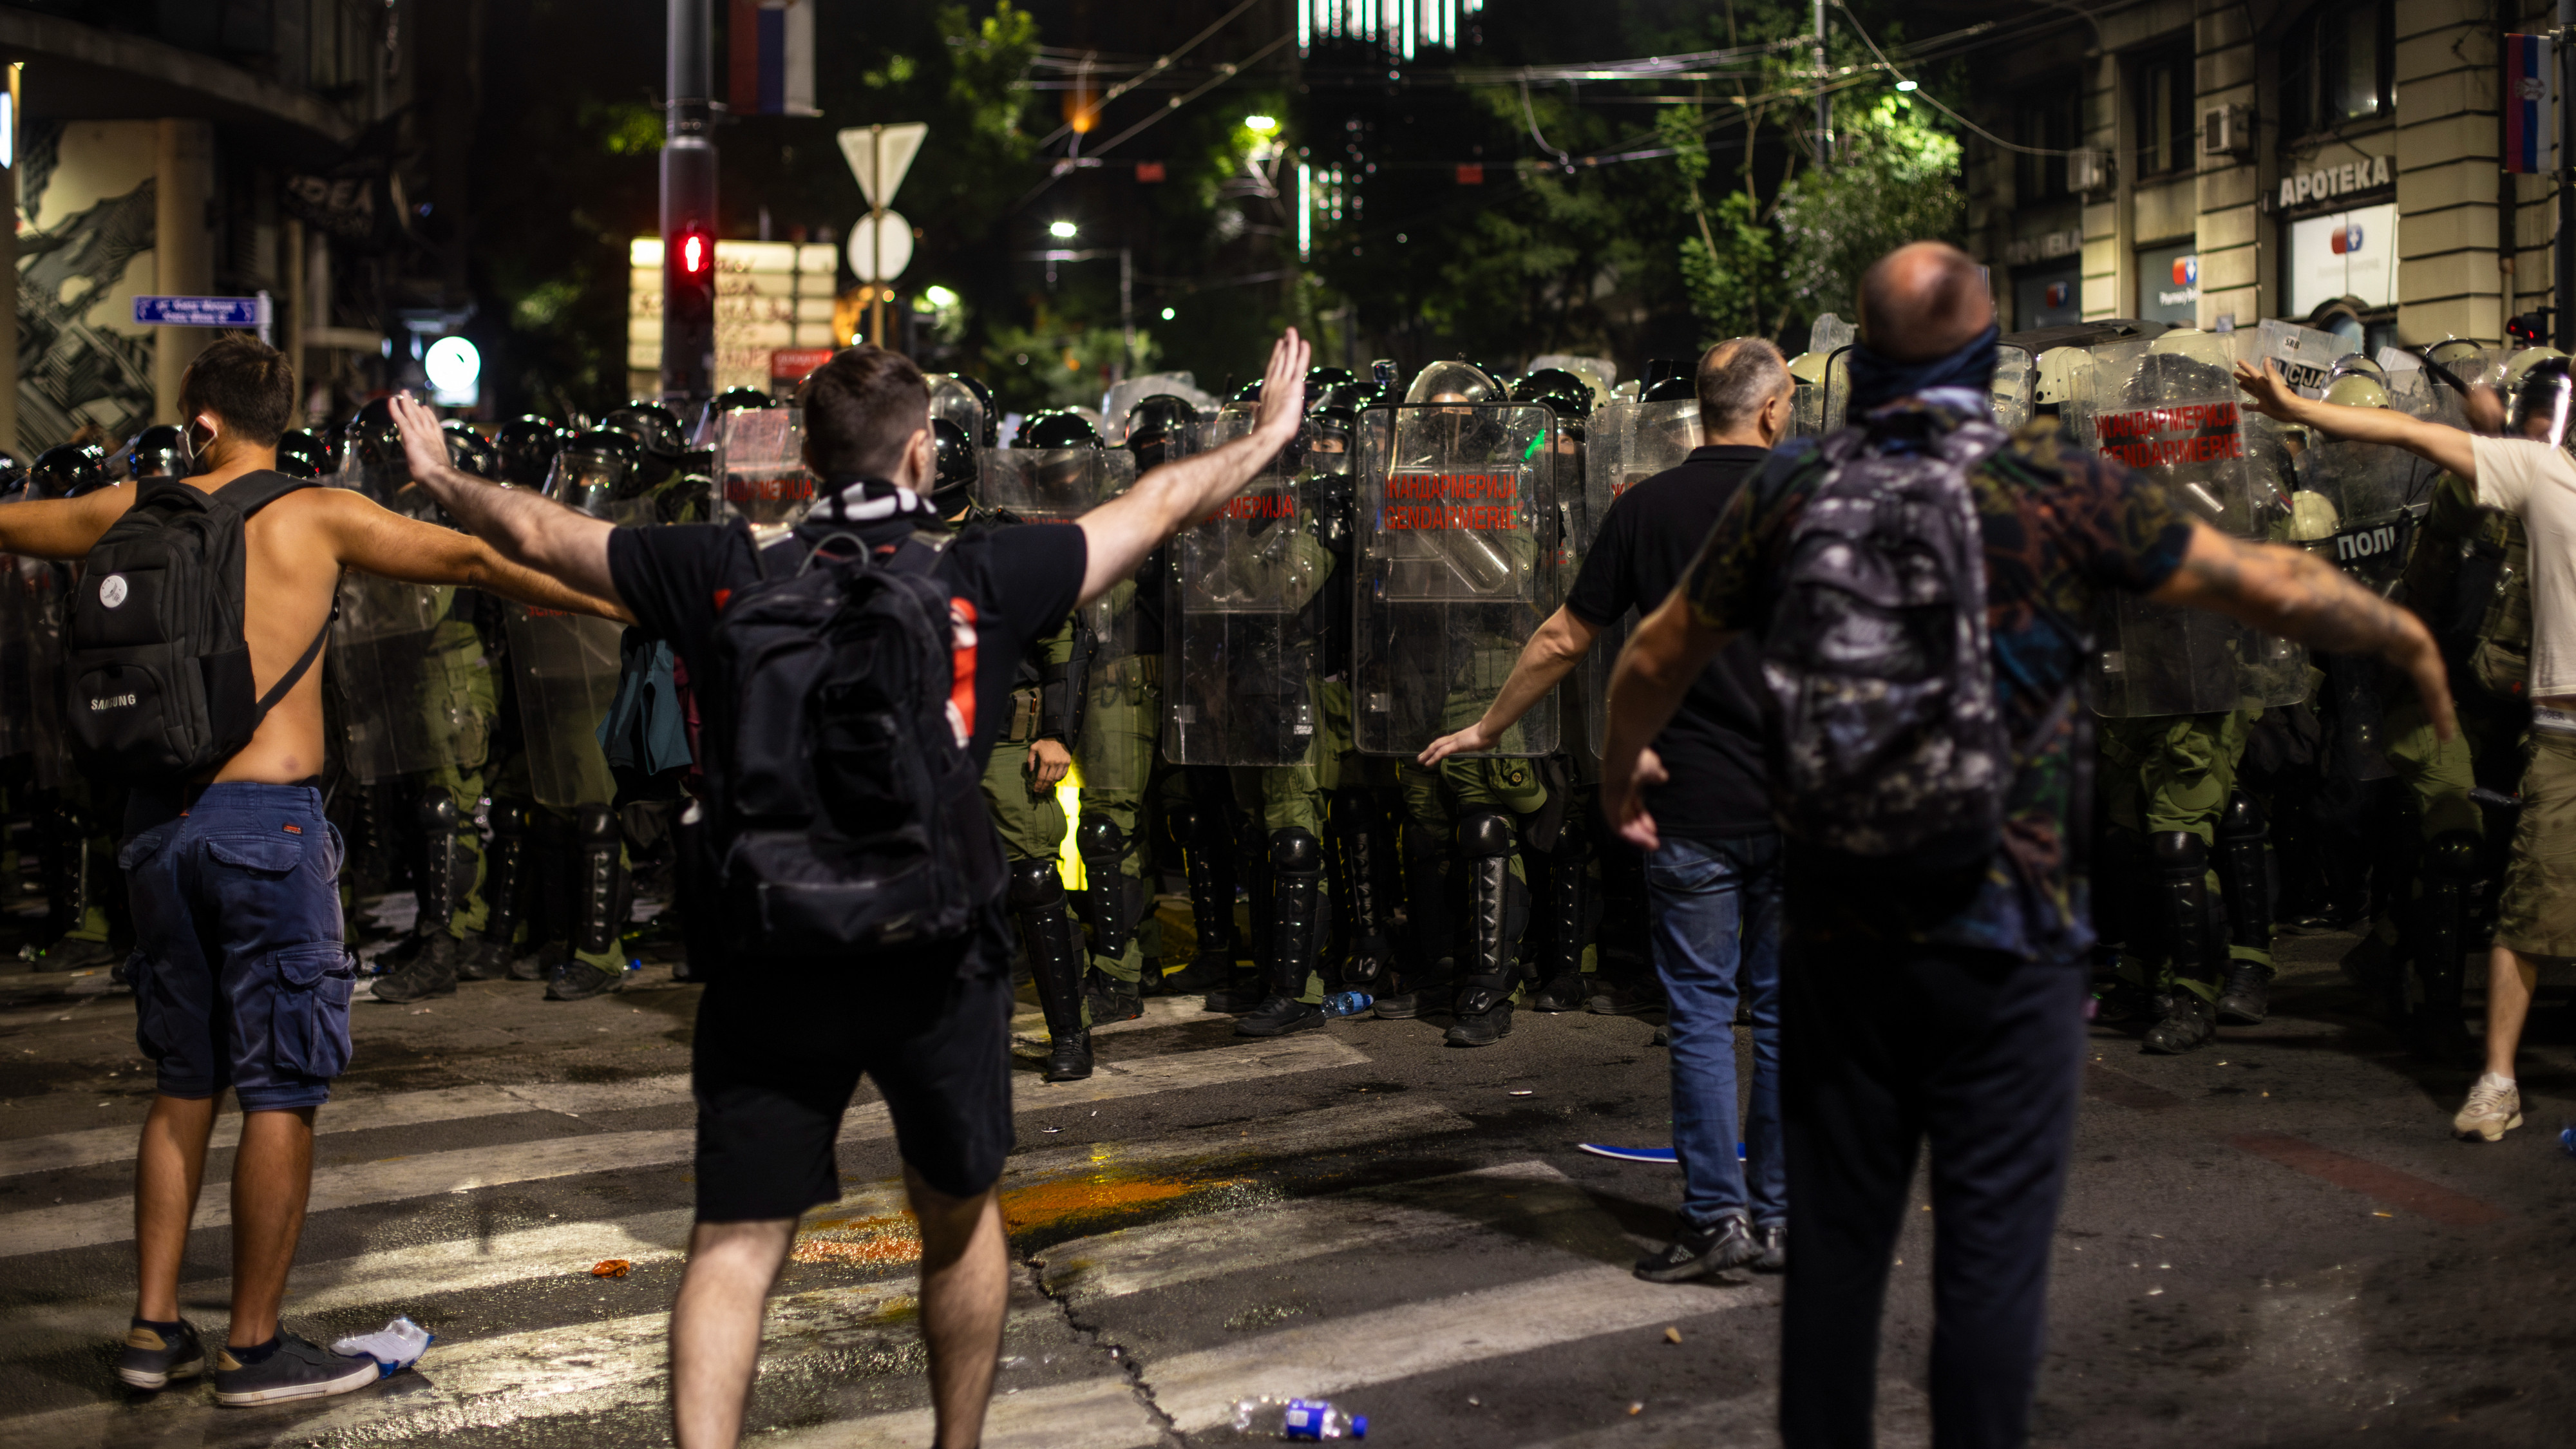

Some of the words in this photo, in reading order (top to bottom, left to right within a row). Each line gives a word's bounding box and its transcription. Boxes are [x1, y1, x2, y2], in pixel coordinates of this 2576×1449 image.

[2279, 156, 2390, 208] APOTEKA
[2285, 337, 2300, 350] SRB
[2095, 401, 2241, 440] ЖАНДАРМЕРИЈА
[1385, 475, 1518, 501] ЖАНДАРМЕРИЈА
[1385, 506, 1518, 529] GENDARMERIE
[91, 694, 136, 710] SAMSUNG
